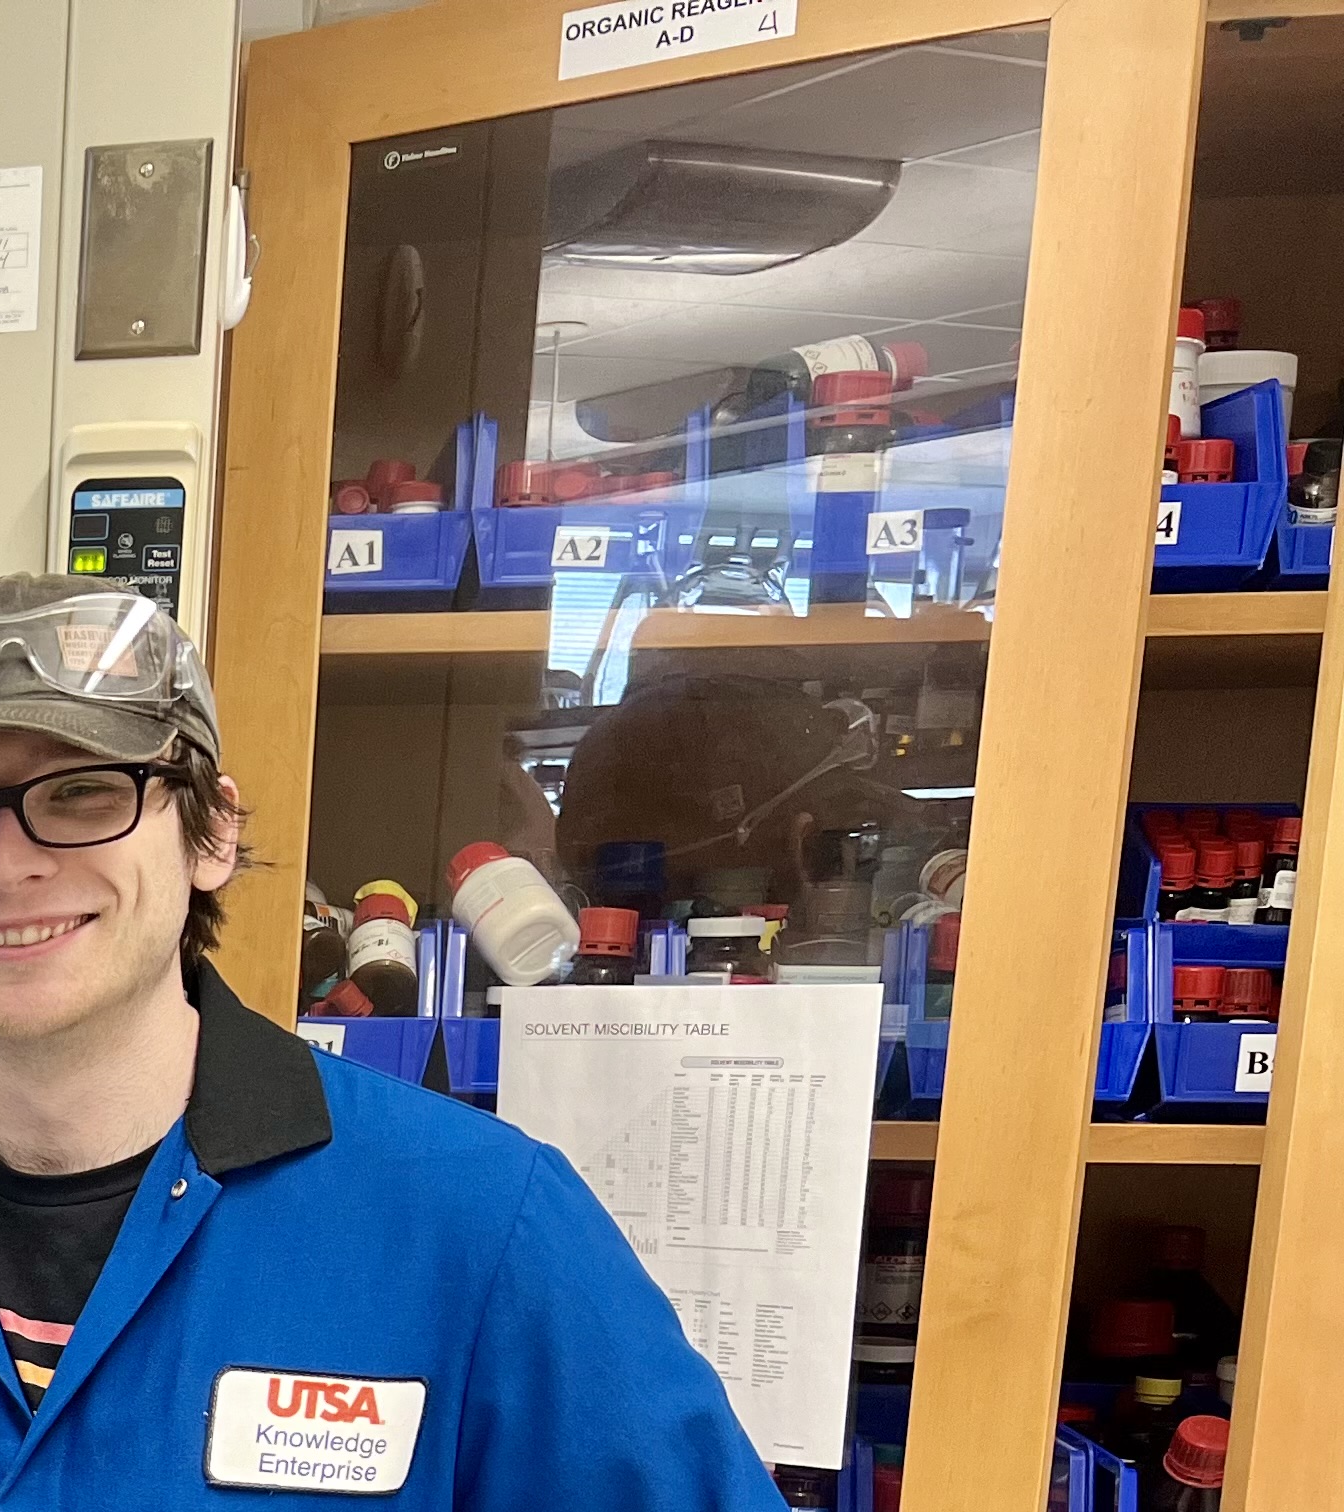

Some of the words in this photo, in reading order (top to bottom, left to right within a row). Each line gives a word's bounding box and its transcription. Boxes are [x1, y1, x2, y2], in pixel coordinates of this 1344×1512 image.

[566, 6, 664, 41] ORGANIC
[672, 0, 772, 20] REAGE
[656, 26, 694, 49] A-D
[92, 493, 166, 507] SAFEAIRE
[873, 518, 918, 548] A3
[1156, 510, 1174, 539] 4
[152, 549, 171, 559] Test
[336, 537, 377, 569] A1
[556, 535, 603, 562] A2
[147, 559, 175, 568] Reset
[131, 576, 172, 584] MONITOR
[524, 1023, 590, 1035] SOLVENT
[594, 1024, 679, 1036] MISCIBILITY
[683, 1024, 730, 1036] TABLE
[1246, 1051, 1274, 1075] B
[267, 1377, 380, 1425] UTSA
[256, 1424, 387, 1458] Knowledge
[259, 1452, 377, 1483] Enterprise
